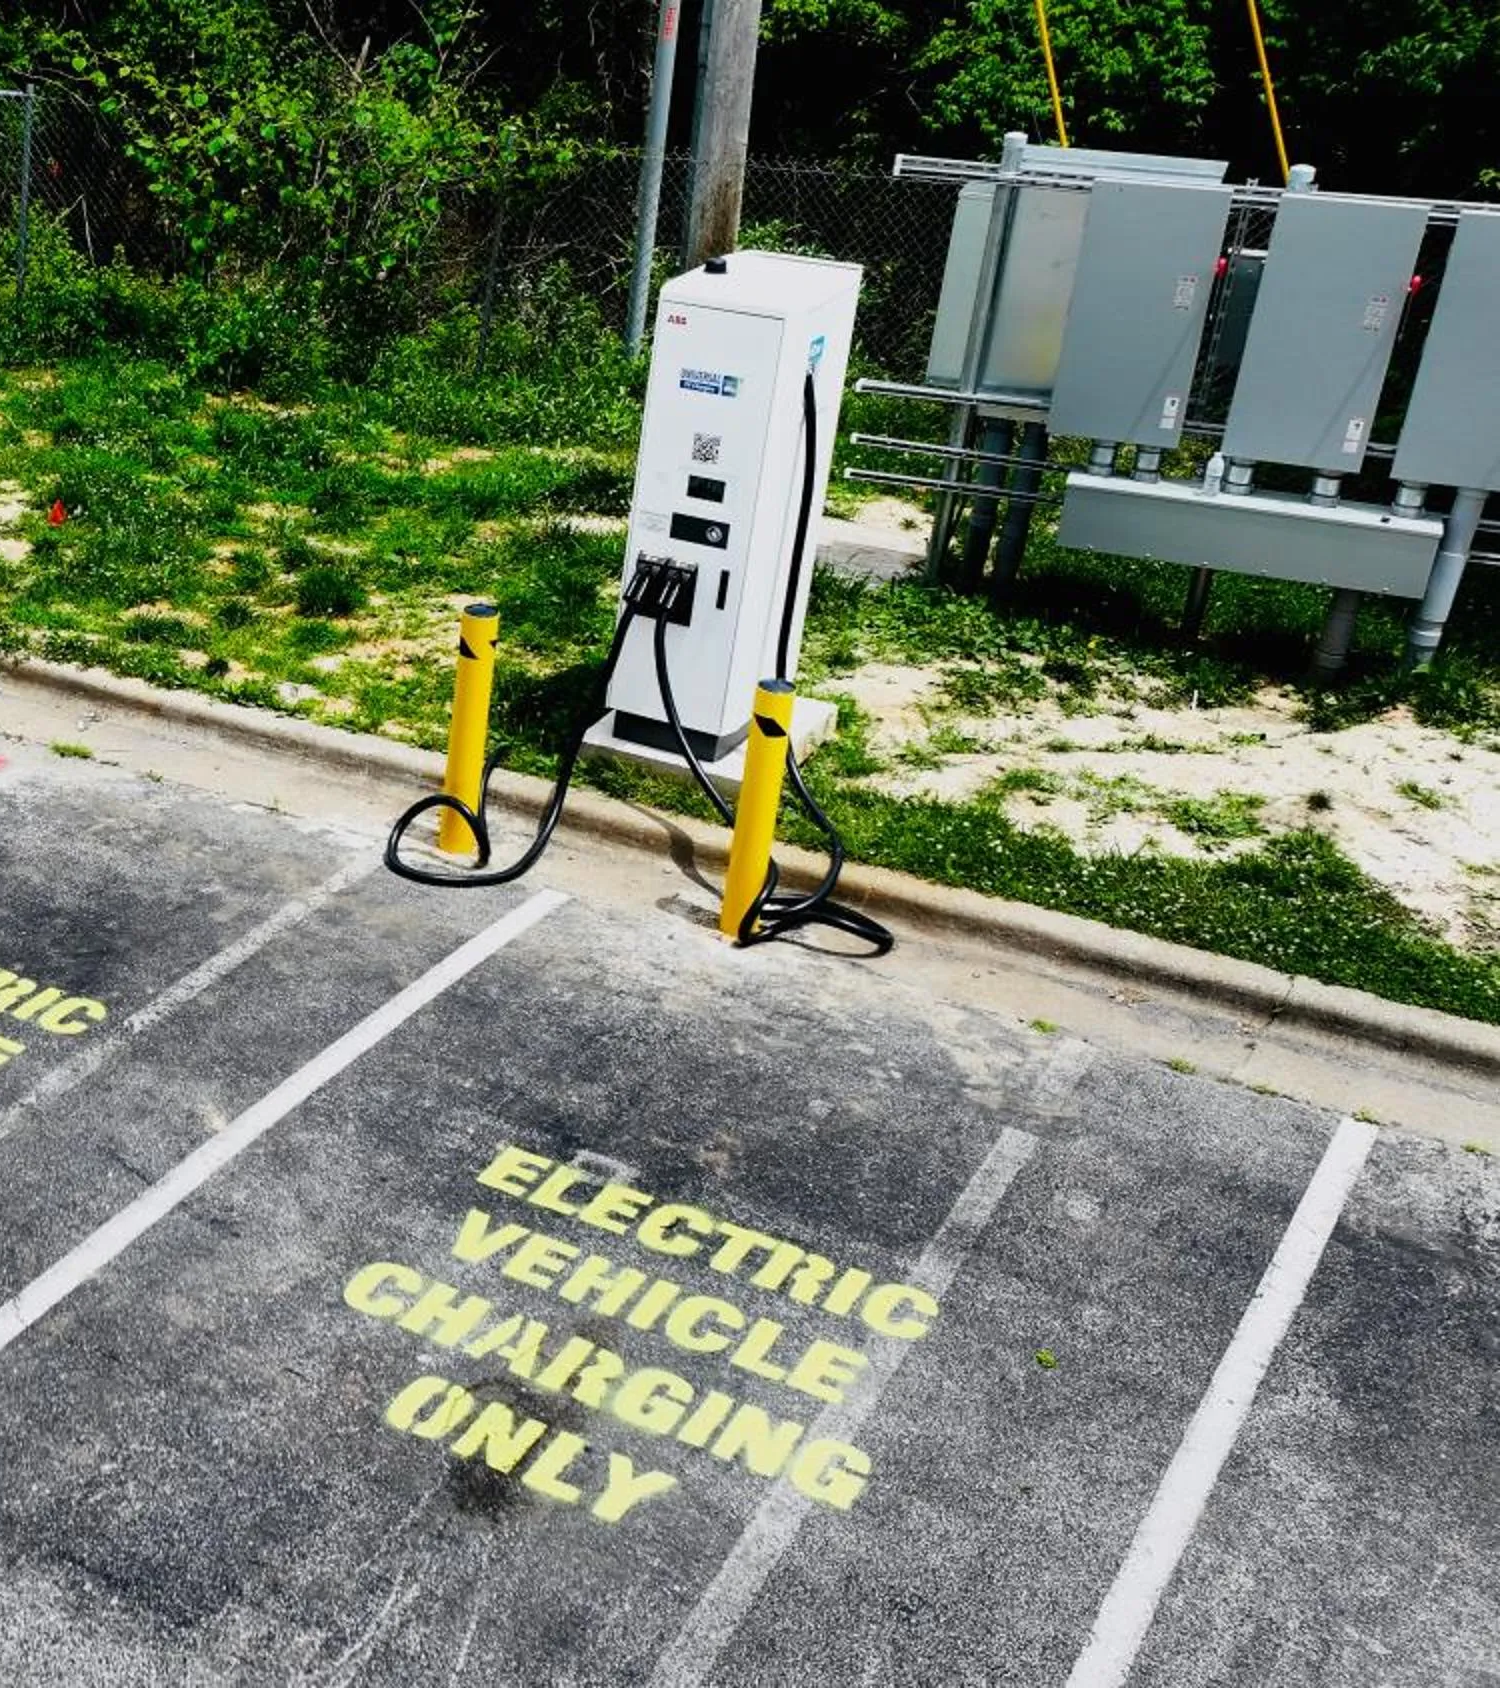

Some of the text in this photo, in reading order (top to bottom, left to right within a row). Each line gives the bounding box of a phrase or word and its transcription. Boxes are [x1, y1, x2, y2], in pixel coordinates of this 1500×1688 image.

[450, 1208, 869, 1403] VEHICLE
[475, 1144, 940, 1340] ELECTRIC
[342, 1261, 873, 1511] CHARGING
[385, 1375, 678, 1524] ONLY
